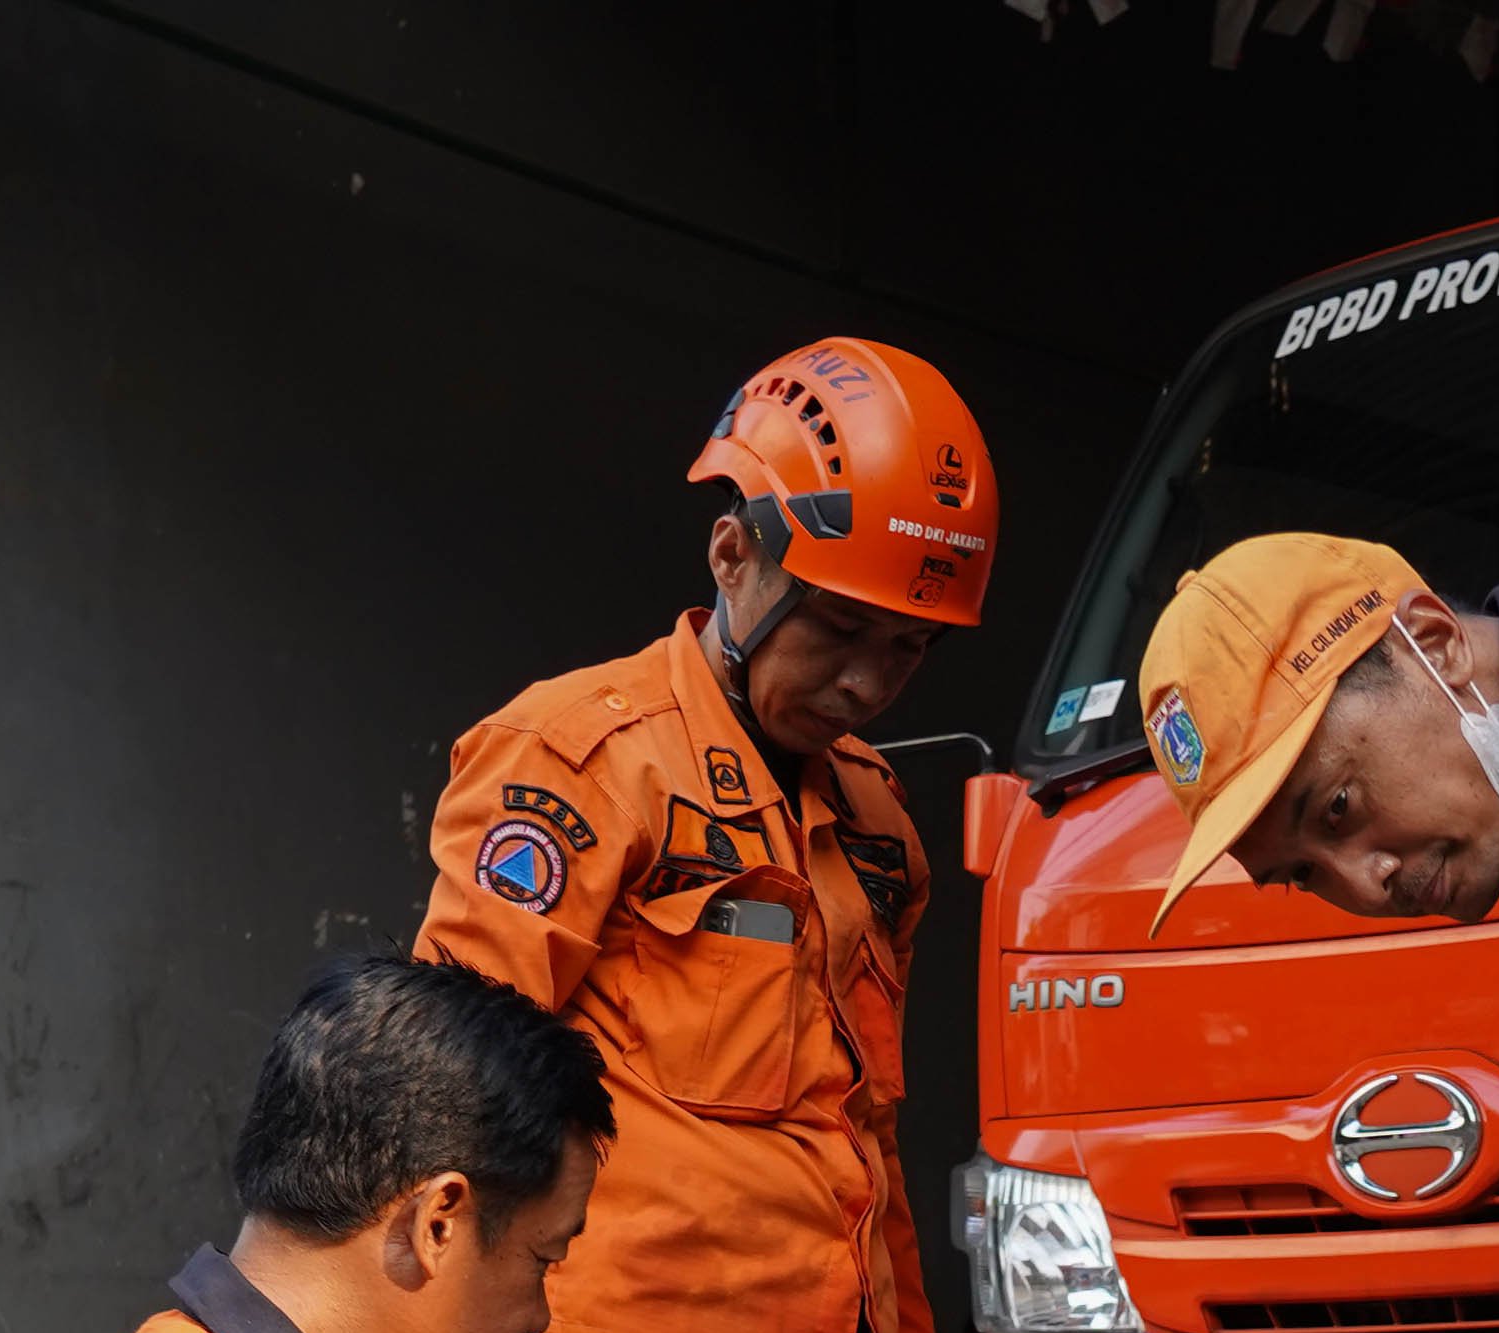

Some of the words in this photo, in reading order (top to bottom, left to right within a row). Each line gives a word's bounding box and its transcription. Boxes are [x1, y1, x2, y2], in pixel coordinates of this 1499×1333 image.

[1275, 279, 1398, 359] BPBD
[889, 517, 923, 538] BPBD
[924, 525, 945, 543] DKI
[1291, 649, 1319, 674] KEL.
[1311, 606, 1362, 653] CILANDAK
[1009, 975, 1124, 1012] HINO
